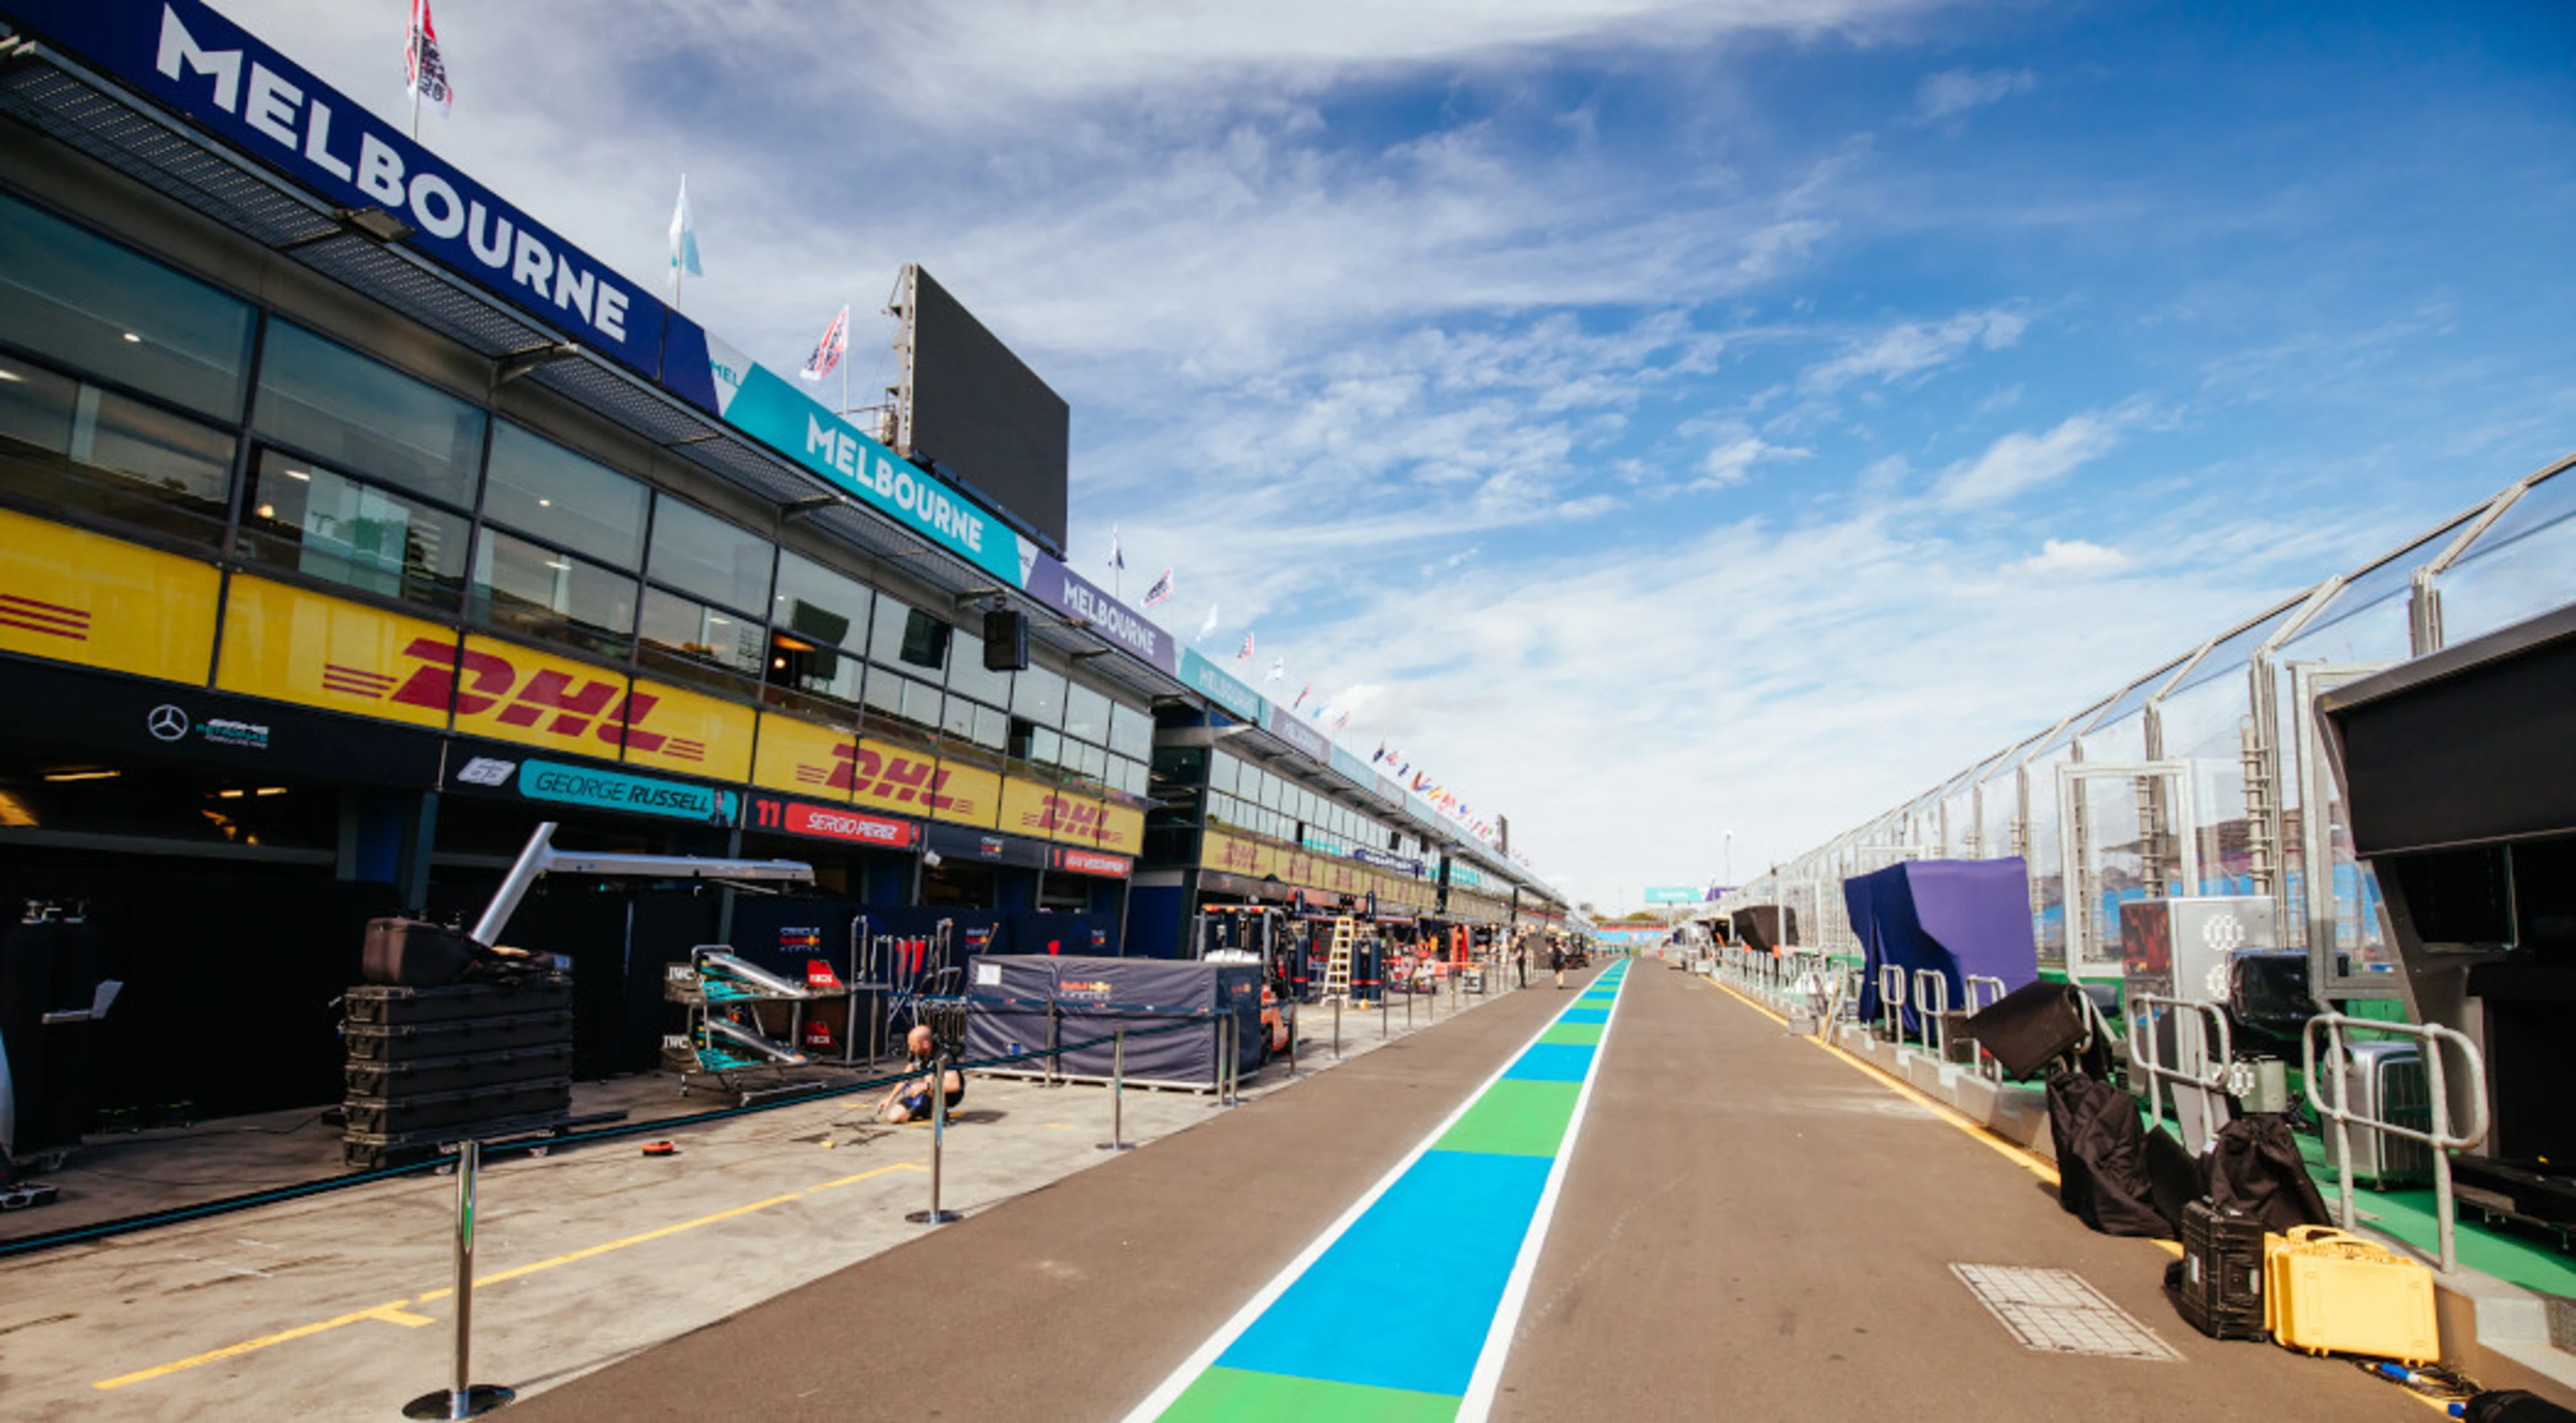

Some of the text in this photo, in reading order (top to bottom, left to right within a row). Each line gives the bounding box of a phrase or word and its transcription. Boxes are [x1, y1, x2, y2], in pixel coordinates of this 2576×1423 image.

[156, 3, 629, 344] MELBOURNE
[806, 412, 983, 553] MELBOURNE
[1063, 578, 1157, 656] MELBOURNE
[390, 637, 666, 752] DHL
[536, 772, 709, 814] GEORGE RUSSELL
[825, 743, 955, 809] DHL
[756, 799, 781, 828] 11
[806, 812, 898, 840] SERGIO PEREZ
[1038, 795, 1110, 841] DHL
[668, 966, 694, 980] IWC
[663, 1035, 689, 1049] IWC
